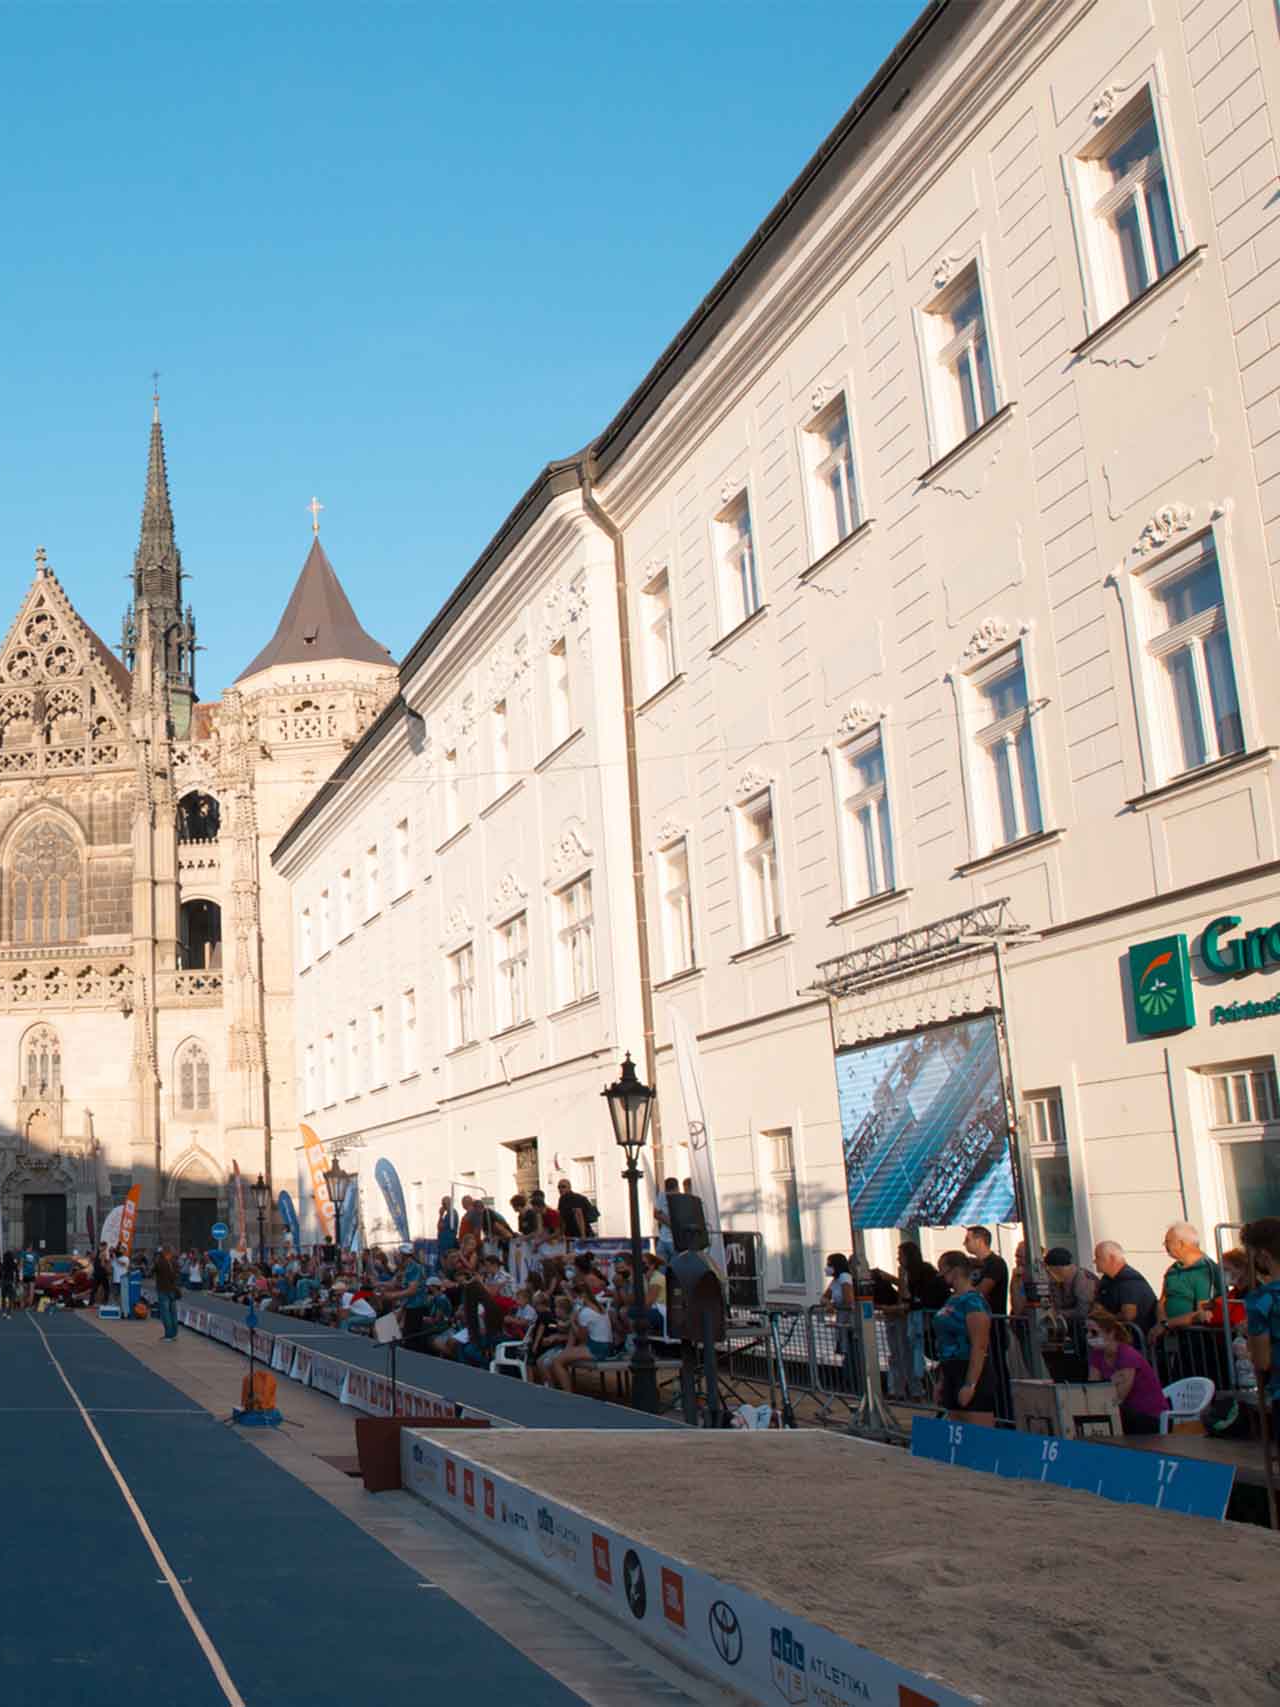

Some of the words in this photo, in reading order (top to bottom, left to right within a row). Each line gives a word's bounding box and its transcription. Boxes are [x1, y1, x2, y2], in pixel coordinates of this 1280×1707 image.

[948, 1425, 964, 1445] 15
[1042, 1440, 1060, 1461] 16
[1157, 1460, 1179, 1484] 17
[810, 1656, 871, 1700] ATLETIKA
